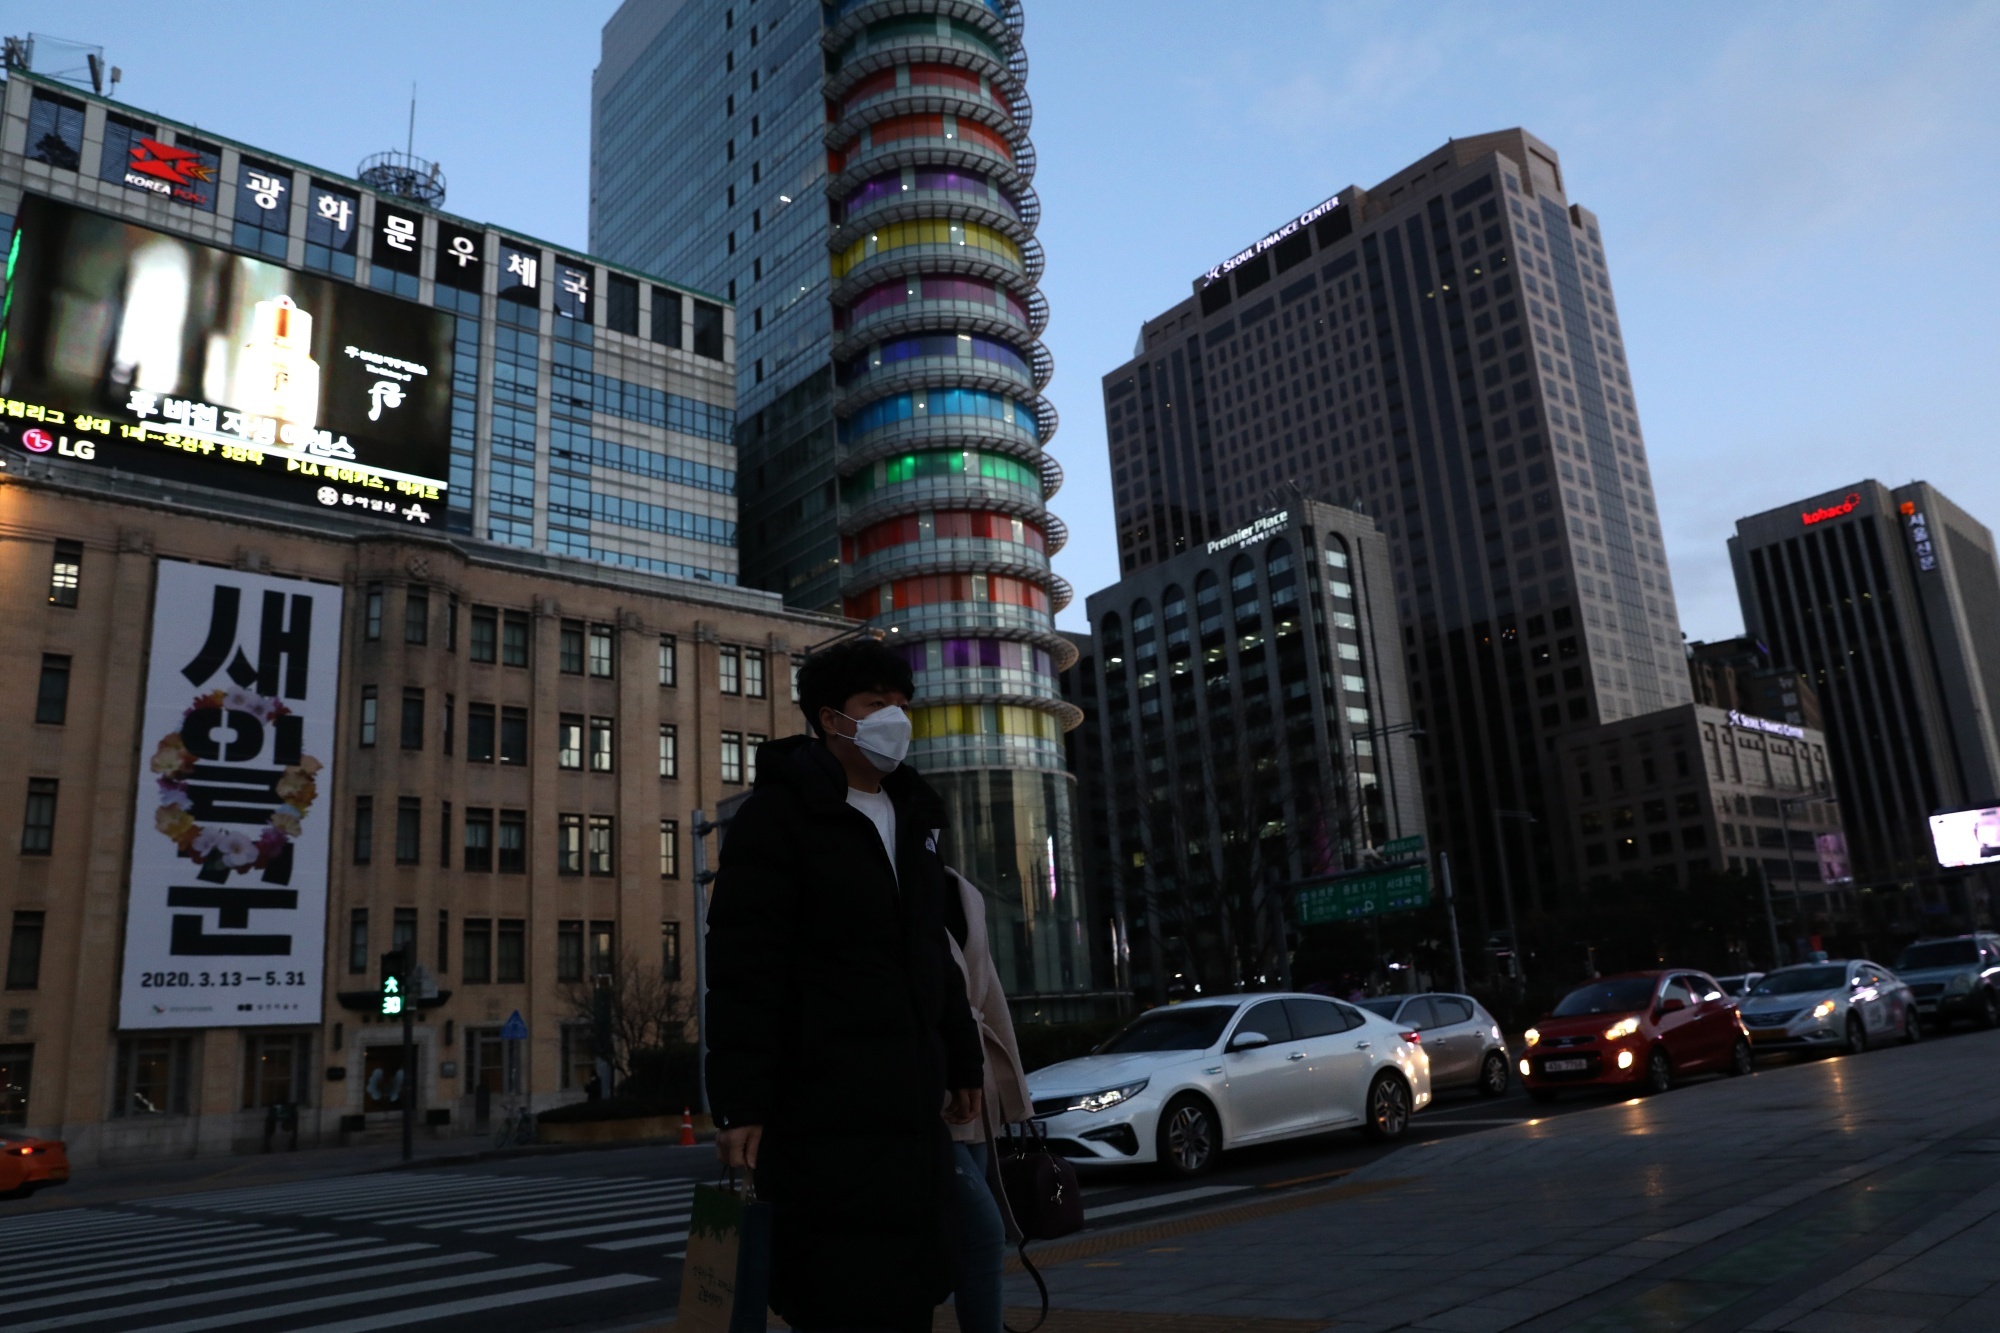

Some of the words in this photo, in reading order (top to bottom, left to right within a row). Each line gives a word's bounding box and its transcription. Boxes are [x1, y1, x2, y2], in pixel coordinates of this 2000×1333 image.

[124, 173, 171, 196] KOREA
[173, 188, 207, 204] POST
[1222, 249, 1254, 274] SEOUL
[1256, 219, 1299, 253] FINANCE
[1300, 196, 1339, 226] CENTER
[126, 389, 158, 419] 후
[58, 436, 95, 460] LG
[301, 461, 319, 476] LA
[1207, 525, 1255, 555] Premier
[1254, 510, 1288, 533] Place
